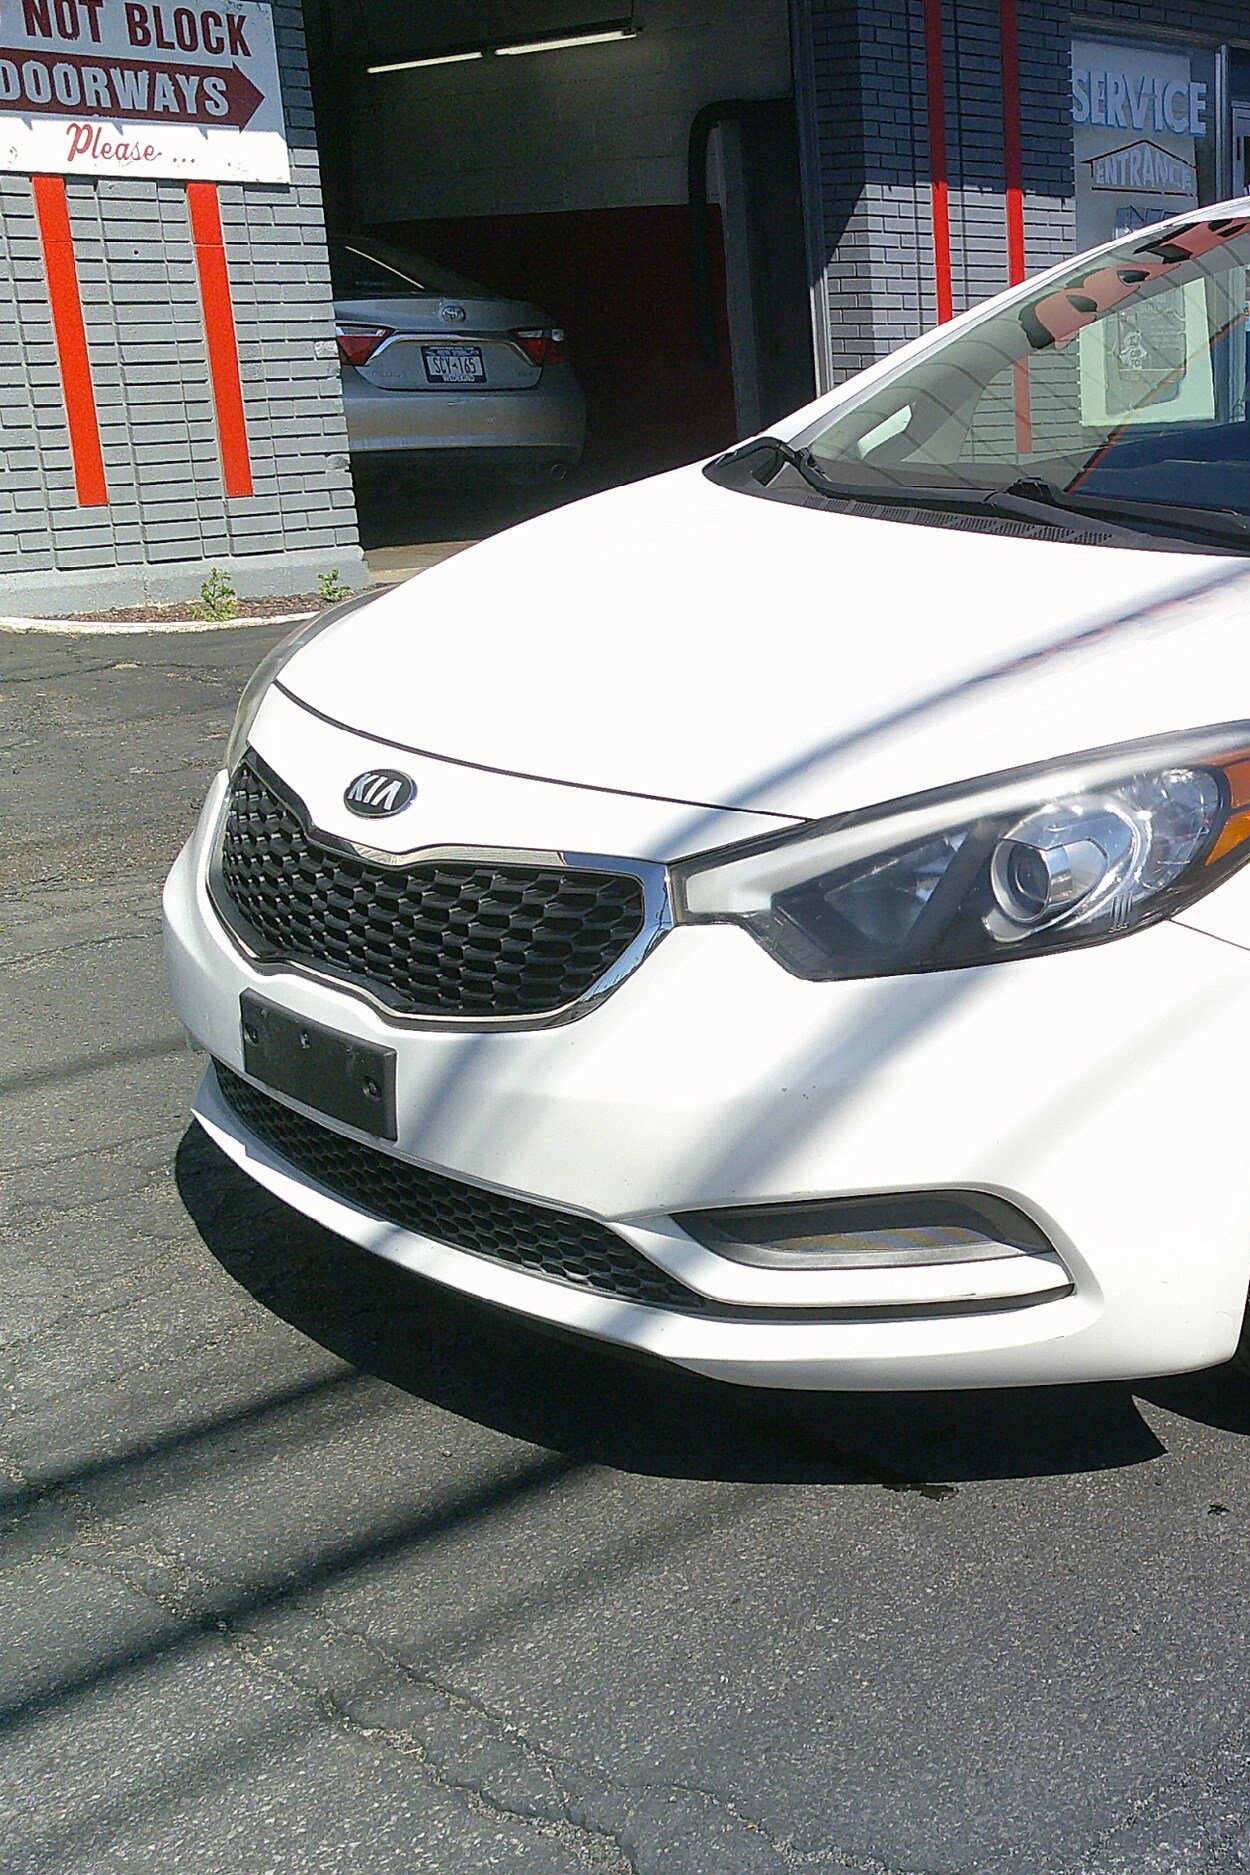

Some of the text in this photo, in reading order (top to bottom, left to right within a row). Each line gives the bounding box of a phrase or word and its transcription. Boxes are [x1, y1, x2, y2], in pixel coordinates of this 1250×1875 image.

[22, 0, 252, 57] NOT BLOCK
[0, 58, 230, 117] DOORWAYS
[1071, 70, 1207, 137] SERVICE
[66, 122, 162, 162] Please
[1095, 144, 1193, 191] ENTRANCE
[347, 772, 403, 811] KIA
